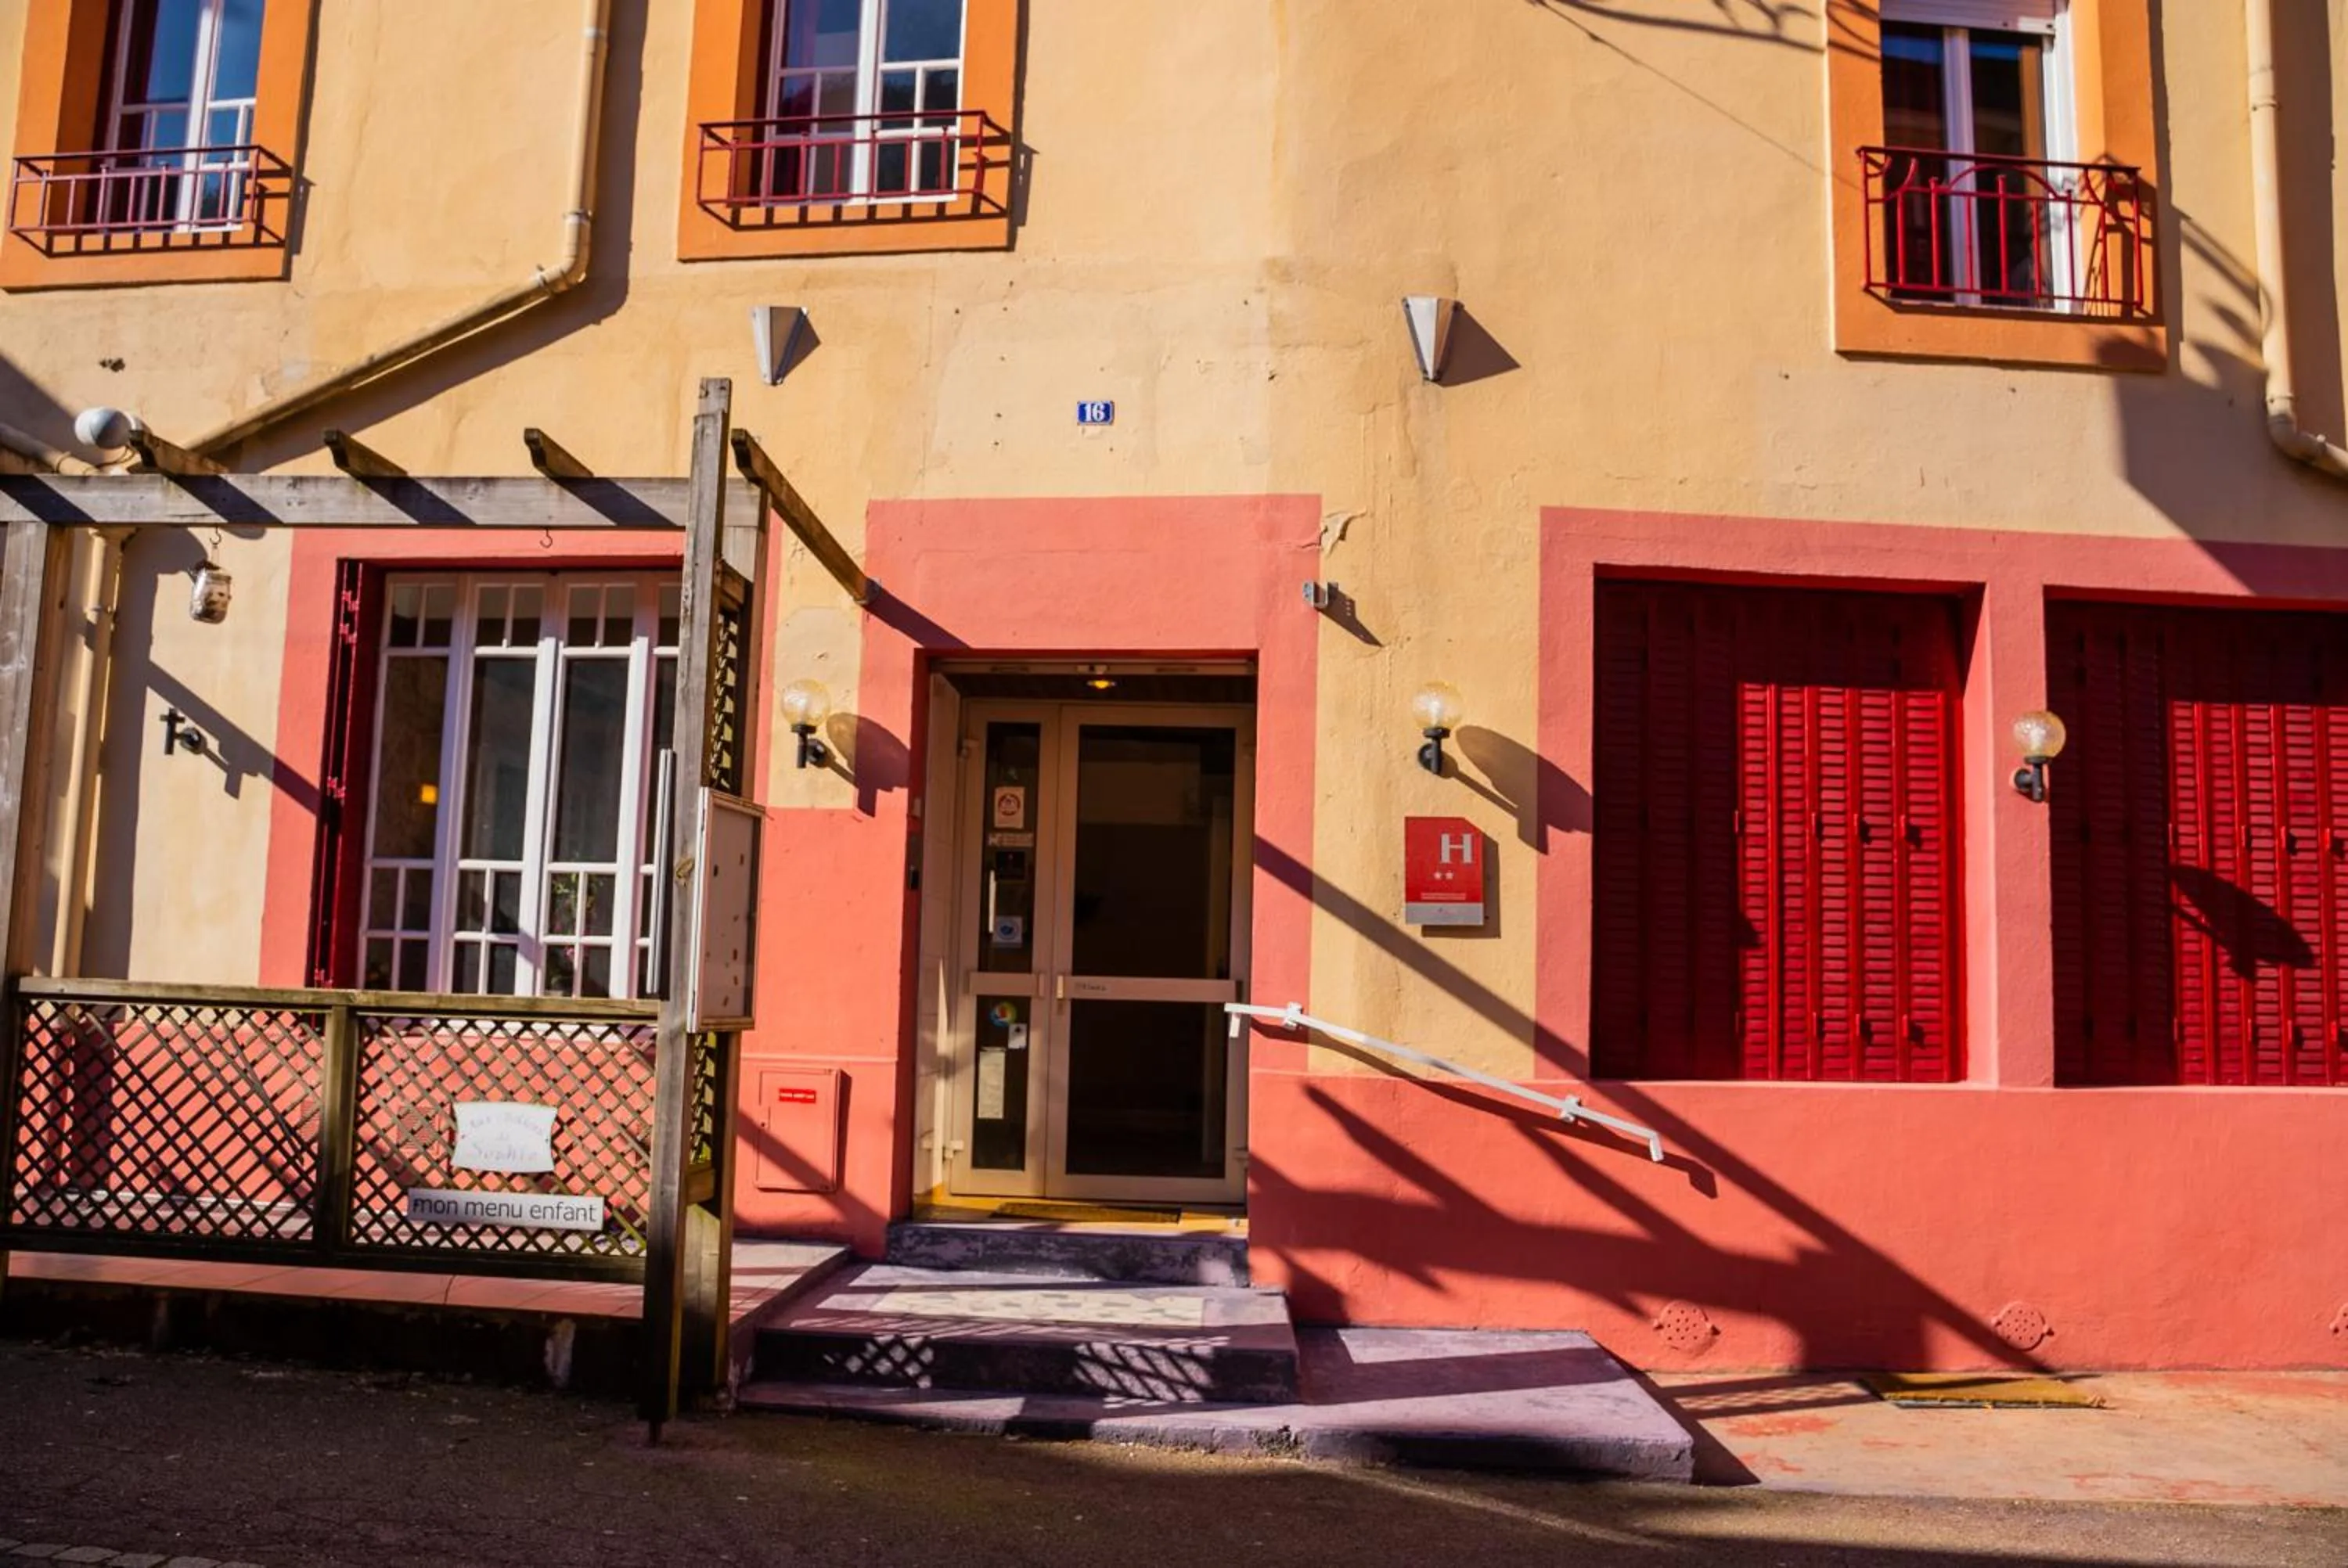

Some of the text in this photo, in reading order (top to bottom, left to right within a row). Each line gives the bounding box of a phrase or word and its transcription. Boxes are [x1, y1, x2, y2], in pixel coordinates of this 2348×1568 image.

[1085, 402, 1105, 422] 16
[1441, 833, 1472, 863] H
[413, 1198, 596, 1222] mon menu enfant
